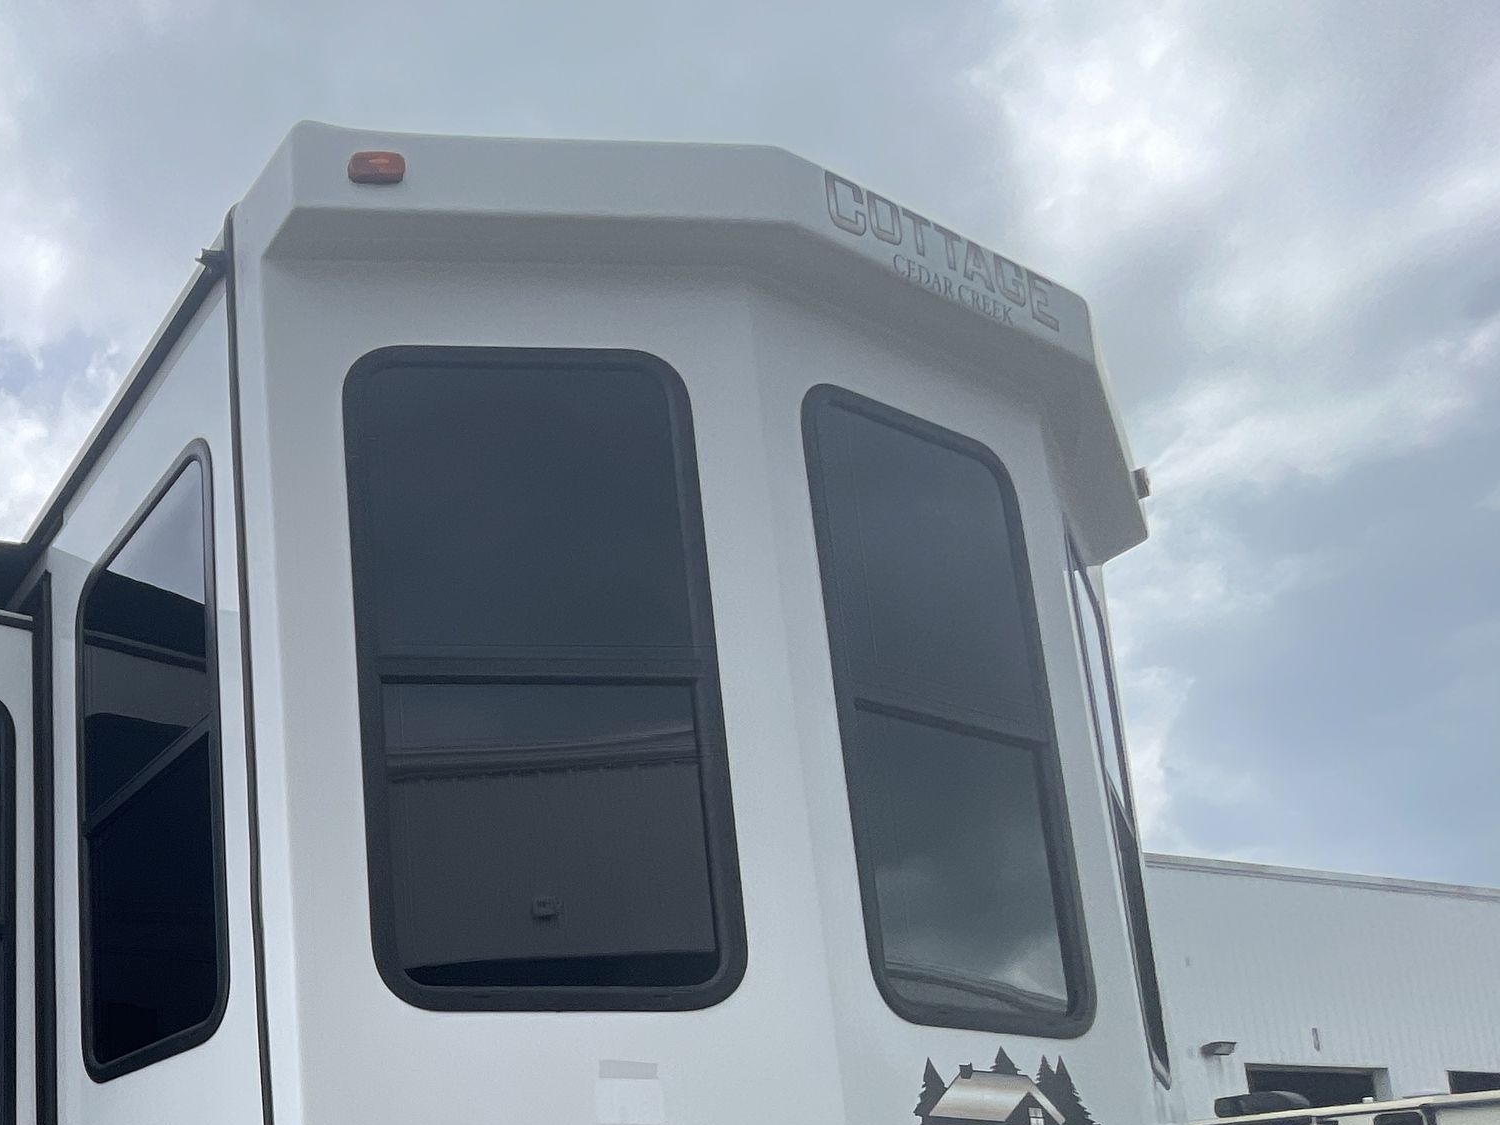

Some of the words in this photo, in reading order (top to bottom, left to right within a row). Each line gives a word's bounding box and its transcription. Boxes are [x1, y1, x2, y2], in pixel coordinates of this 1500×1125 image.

[824, 169, 1060, 332] COTTAGE
[893, 254, 954, 299] CEDAR
[958, 285, 1014, 327] CREEK
